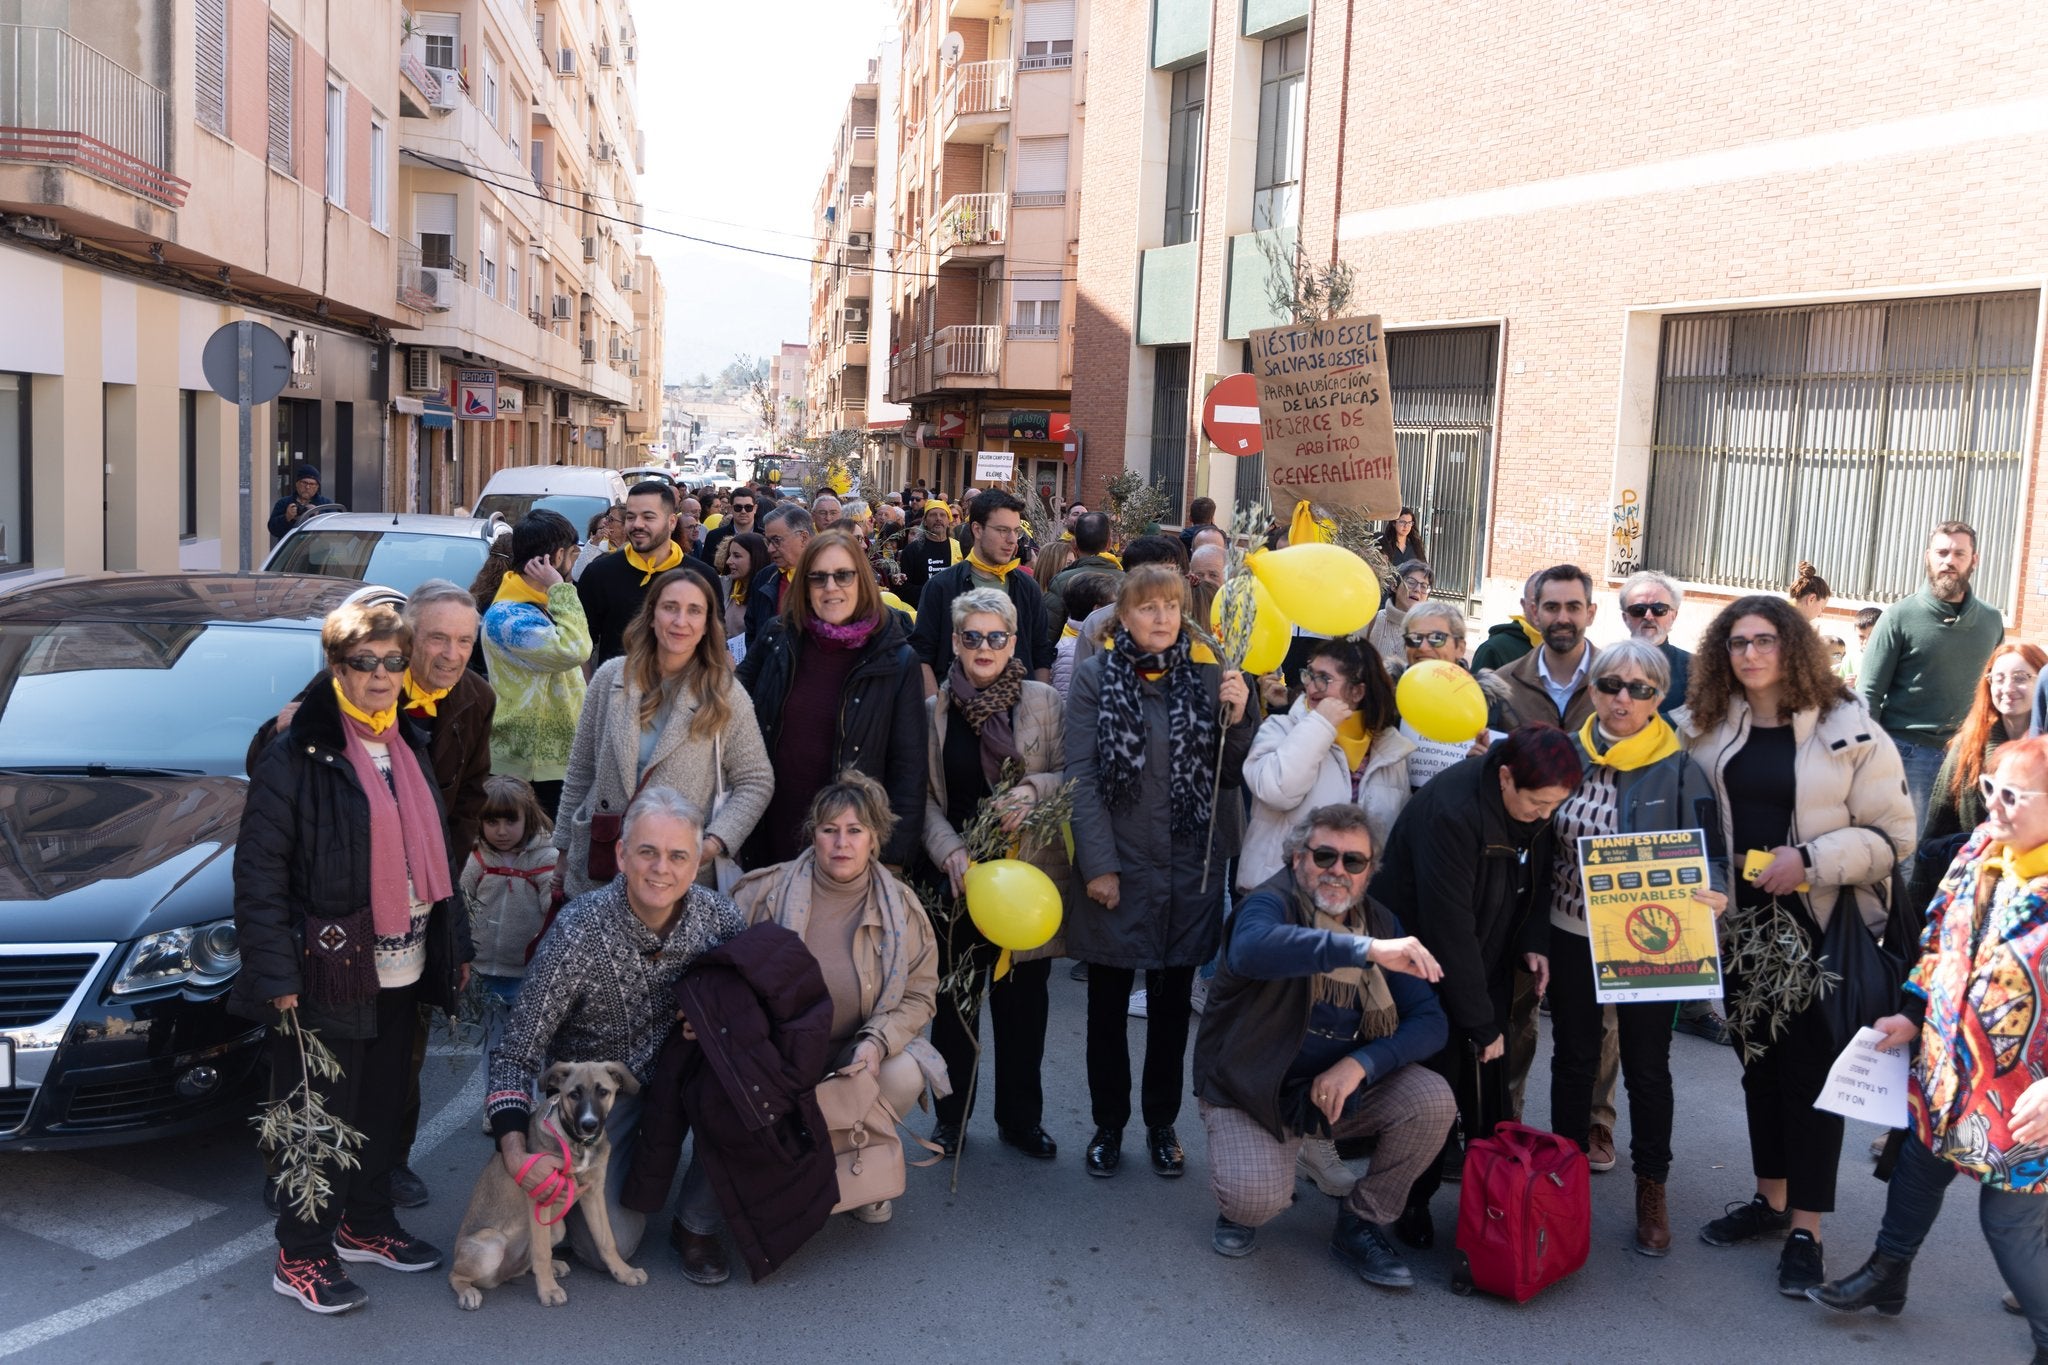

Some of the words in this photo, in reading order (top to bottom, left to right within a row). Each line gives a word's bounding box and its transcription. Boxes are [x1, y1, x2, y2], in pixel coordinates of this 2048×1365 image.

[1310, 327, 1335, 348] NO
[1264, 352, 1326, 377] SALVAJE
[1264, 382, 1294, 401] PARA
[1296, 378, 1309, 395] LA
[1283, 400, 1303, 413] DE
[1305, 395, 1328, 410] LAS
[1330, 388, 1380, 406] PLACAS
[1341, 409, 1365, 427] DE
[1410, 758, 1439, 767] SALVAD
[1588, 849, 1602, 864] 4
[1590, 888, 1687, 906] RENOVABLES
[1653, 965, 1671, 975] NO
